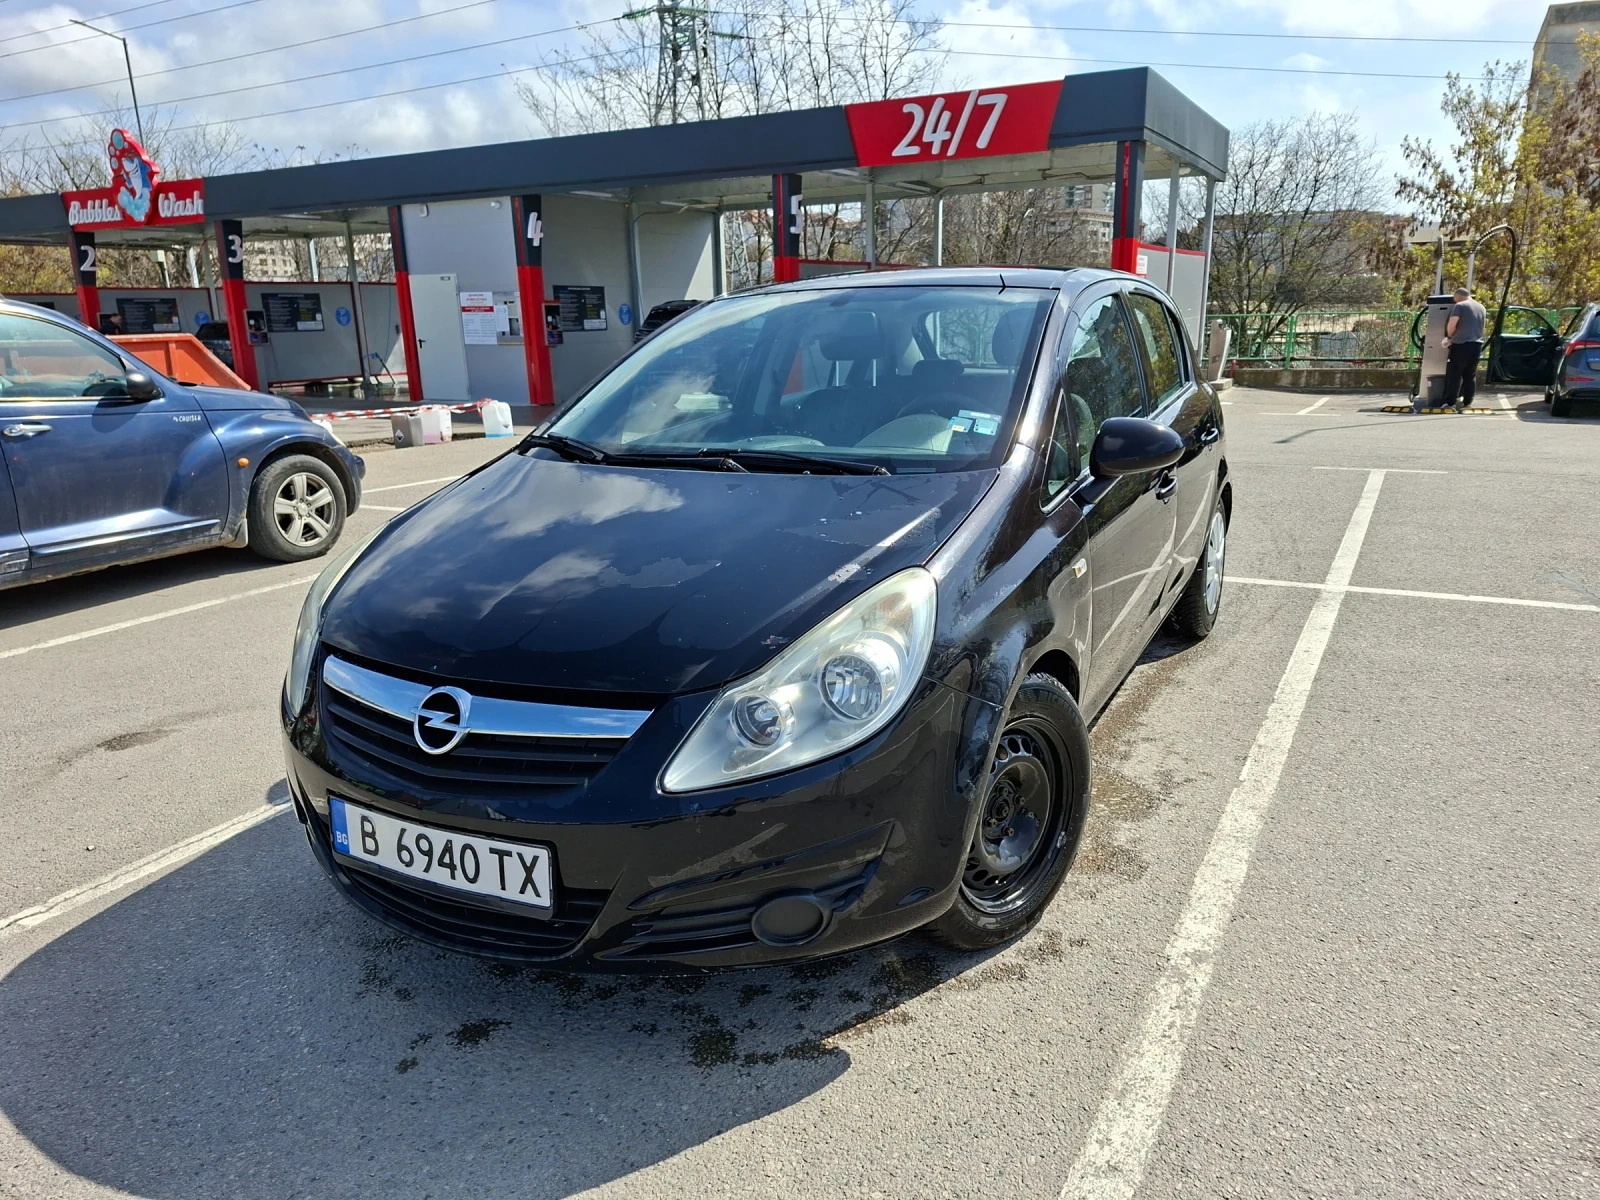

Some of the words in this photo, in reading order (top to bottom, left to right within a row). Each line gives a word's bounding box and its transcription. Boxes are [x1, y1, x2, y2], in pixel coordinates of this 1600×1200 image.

[891, 89, 1008, 157] 24/7
[68, 198, 122, 226] Bubbles
[158, 190, 203, 218] Wash
[790, 194, 804, 234] 5
[527, 211, 544, 247] 4
[80, 245, 96, 271] 2
[228, 234, 244, 263] 3
[336, 831, 348, 844] BG
[360, 815, 380, 857] B
[396, 827, 481, 885] 6940
[488, 846, 542, 899] TX
